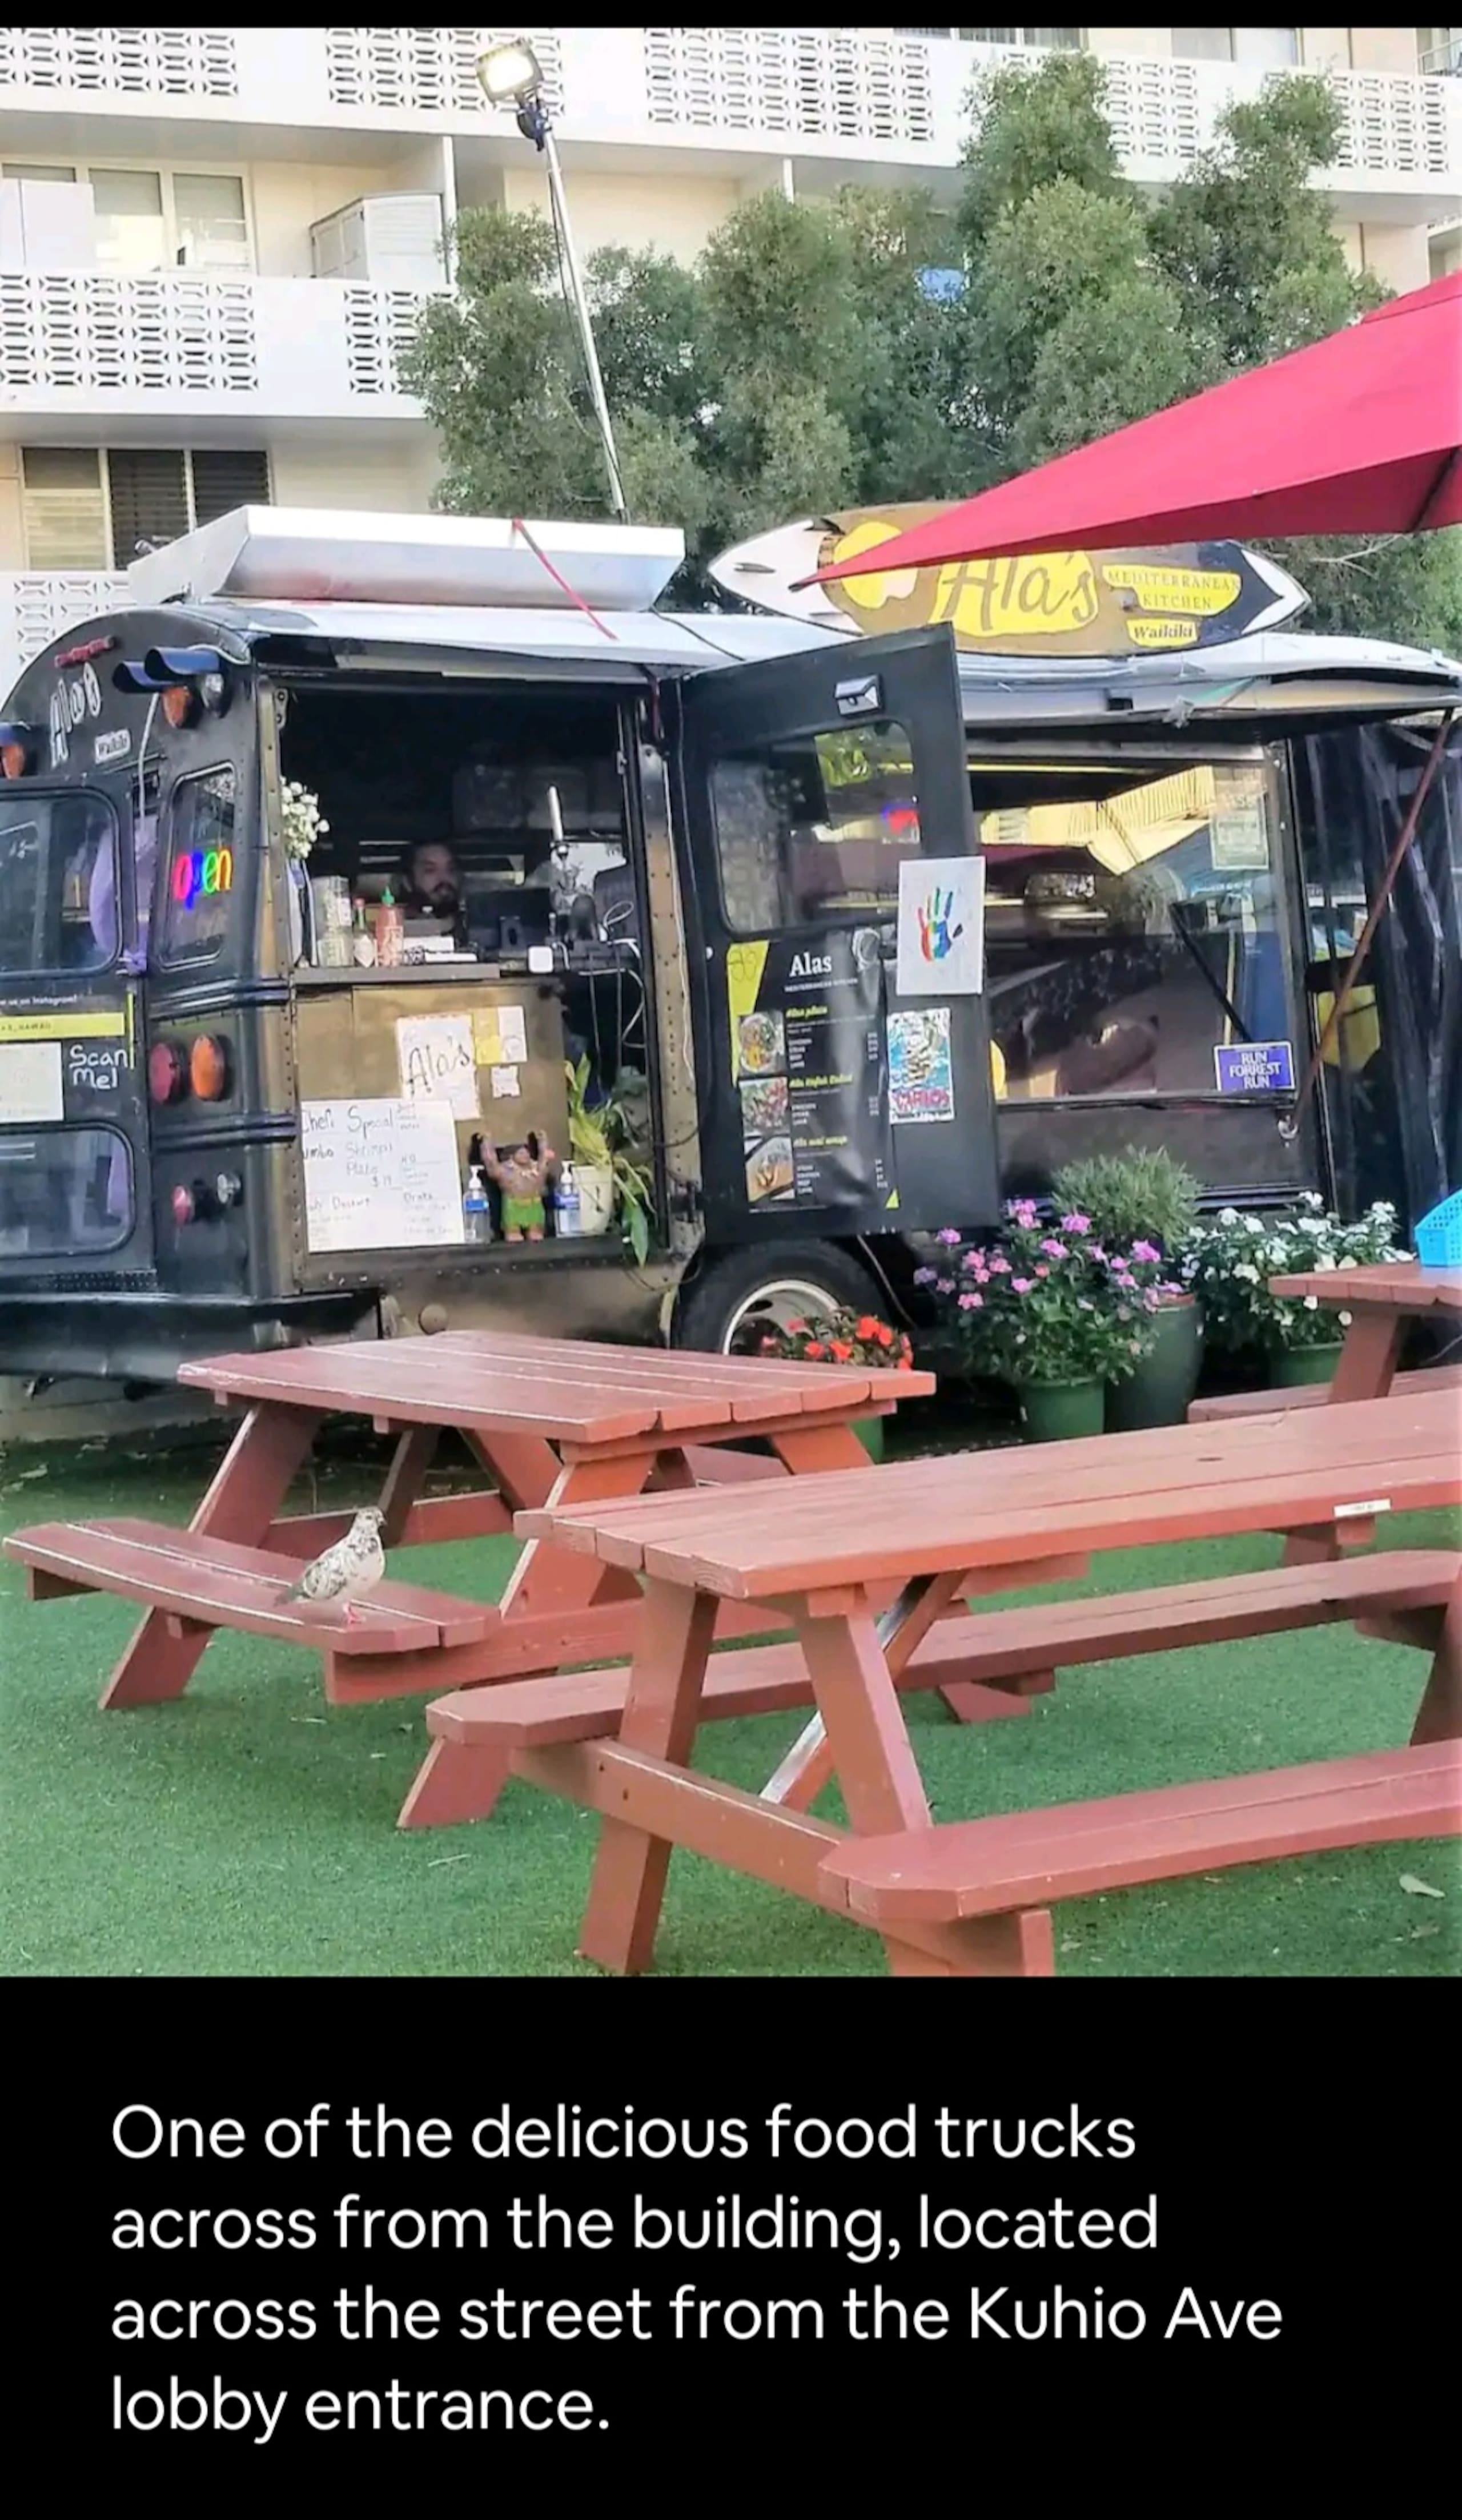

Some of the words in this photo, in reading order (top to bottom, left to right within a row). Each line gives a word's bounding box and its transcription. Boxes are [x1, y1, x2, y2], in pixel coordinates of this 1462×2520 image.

[1108, 571, 1239, 591] MEDITERRANEAN
[1144, 595, 1211, 608] KITCHEN
[1134, 623, 1193, 639] Waikiki
[789, 952, 832, 977] Alas
[69, 1044, 128, 1069] Scan
[1241, 1051, 1268, 1066] RUN
[407, 1035, 470, 1096] Ala's
[1230, 1061, 1282, 1078] FORREST
[1243, 1075, 1270, 1089] RUN
